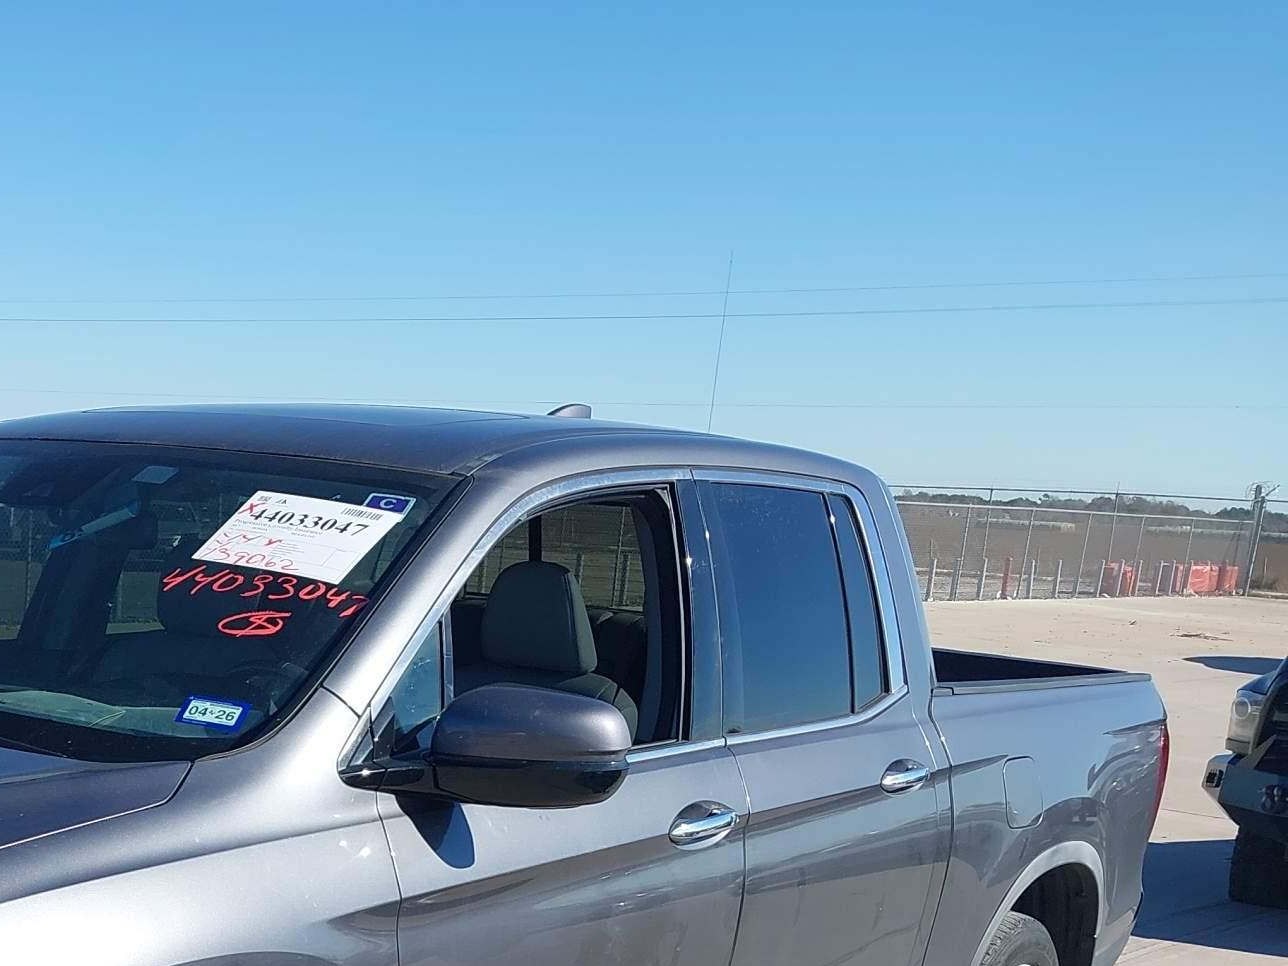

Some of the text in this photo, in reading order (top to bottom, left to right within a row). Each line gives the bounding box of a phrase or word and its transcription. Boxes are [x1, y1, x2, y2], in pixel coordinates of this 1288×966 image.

[379, 498, 397, 509] C
[250, 508, 371, 536] 44033047
[163, 565, 369, 618] 44033047
